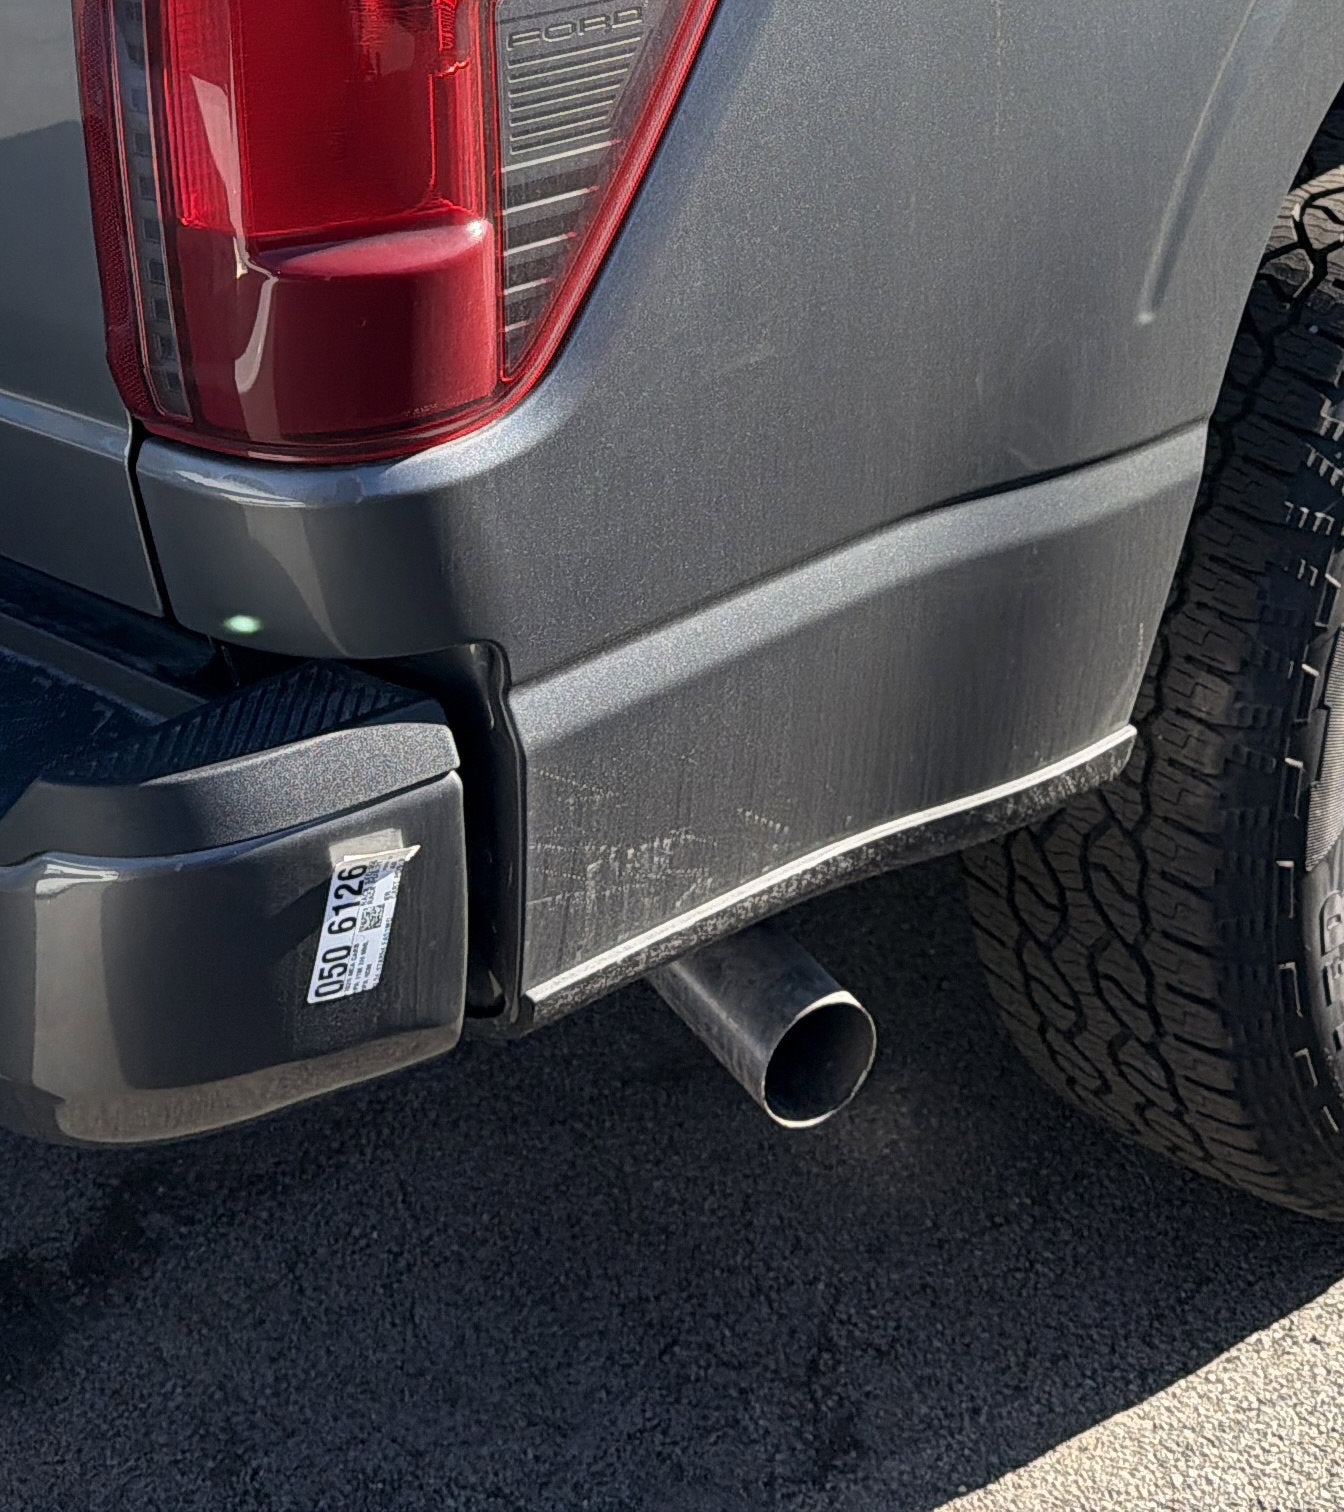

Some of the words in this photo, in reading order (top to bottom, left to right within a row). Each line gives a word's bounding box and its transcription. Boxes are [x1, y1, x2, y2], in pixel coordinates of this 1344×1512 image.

[507, 5, 643, 52] FORD
[328, 864, 368, 935] 6126
[314, 945, 351, 999] 050
